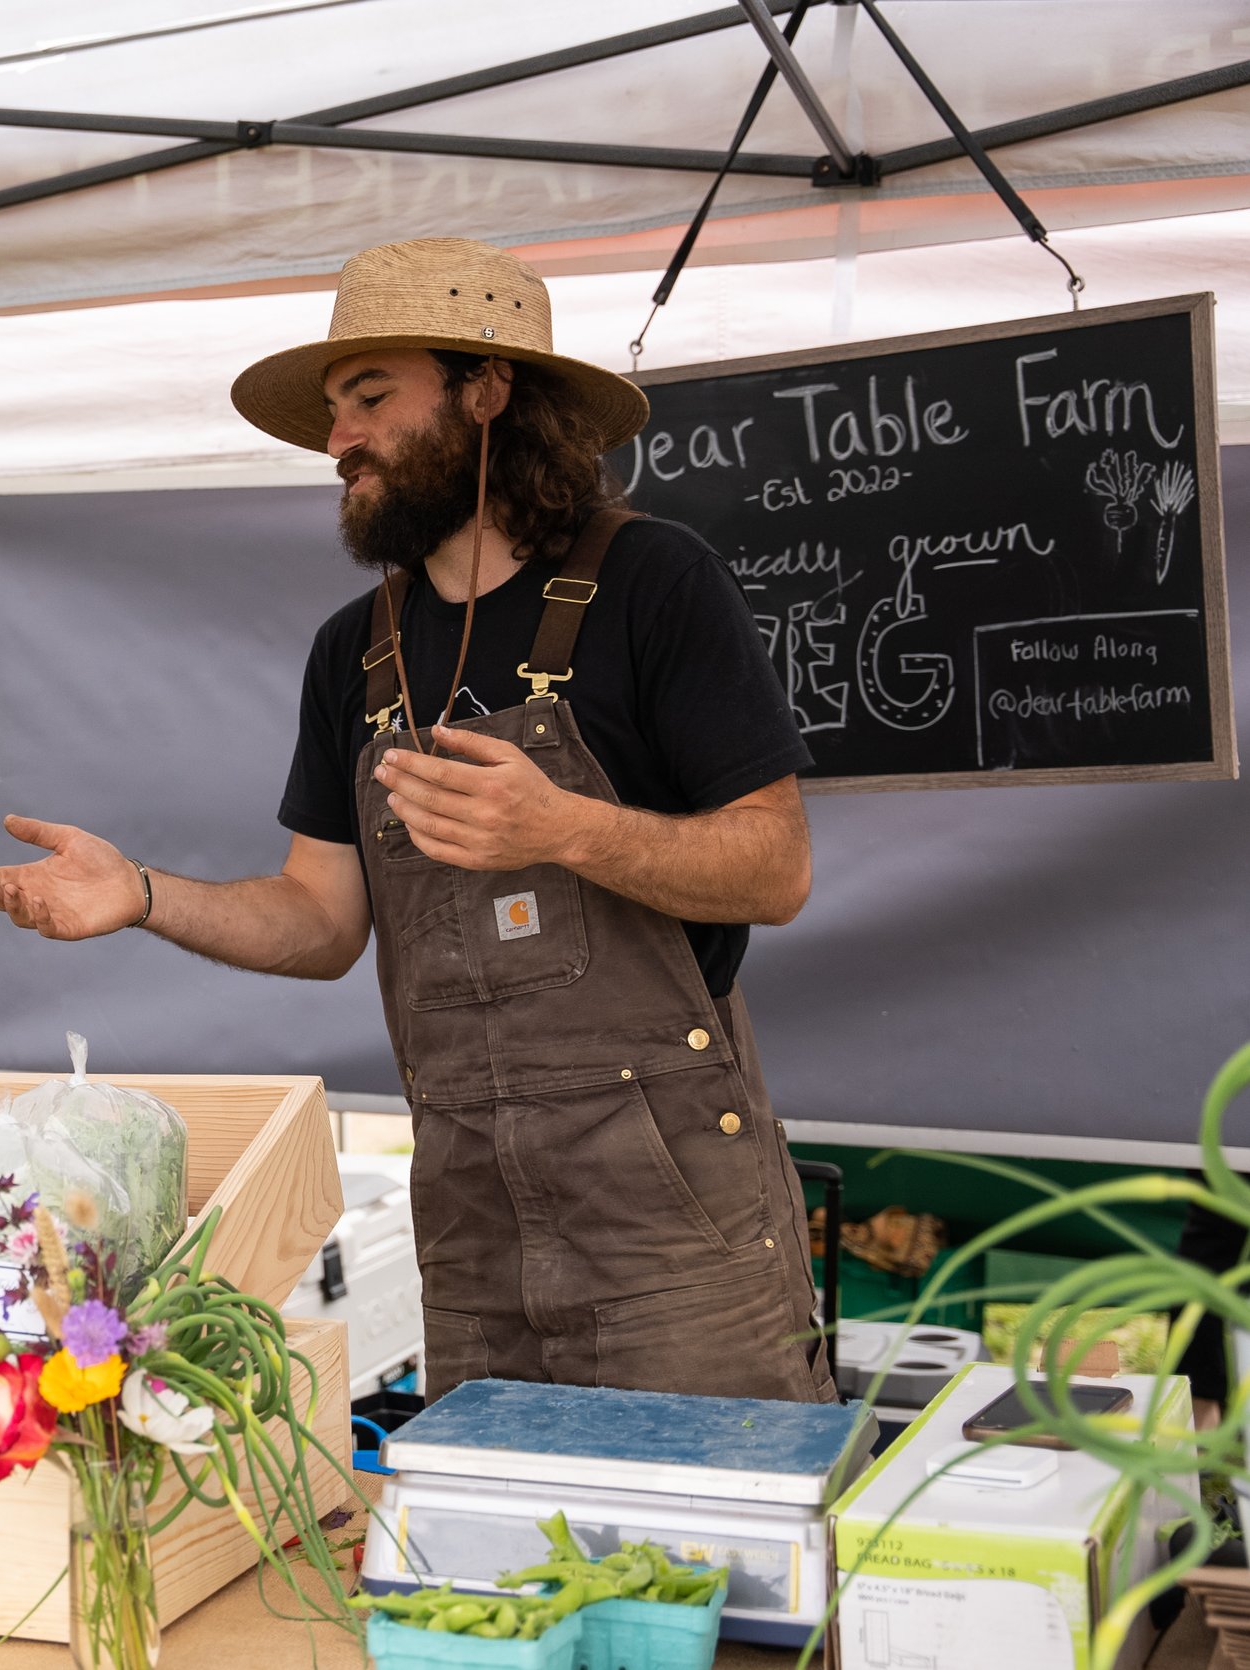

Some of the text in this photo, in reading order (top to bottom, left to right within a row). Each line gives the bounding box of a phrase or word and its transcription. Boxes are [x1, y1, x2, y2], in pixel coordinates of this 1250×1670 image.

[773, 375, 970, 464] Table
[1016, 348, 1185, 449] Farm
[889, 523, 1054, 619] grown
[1011, 634, 1158, 666] Follow Along
[904, 1556, 932, 1569] BAG
